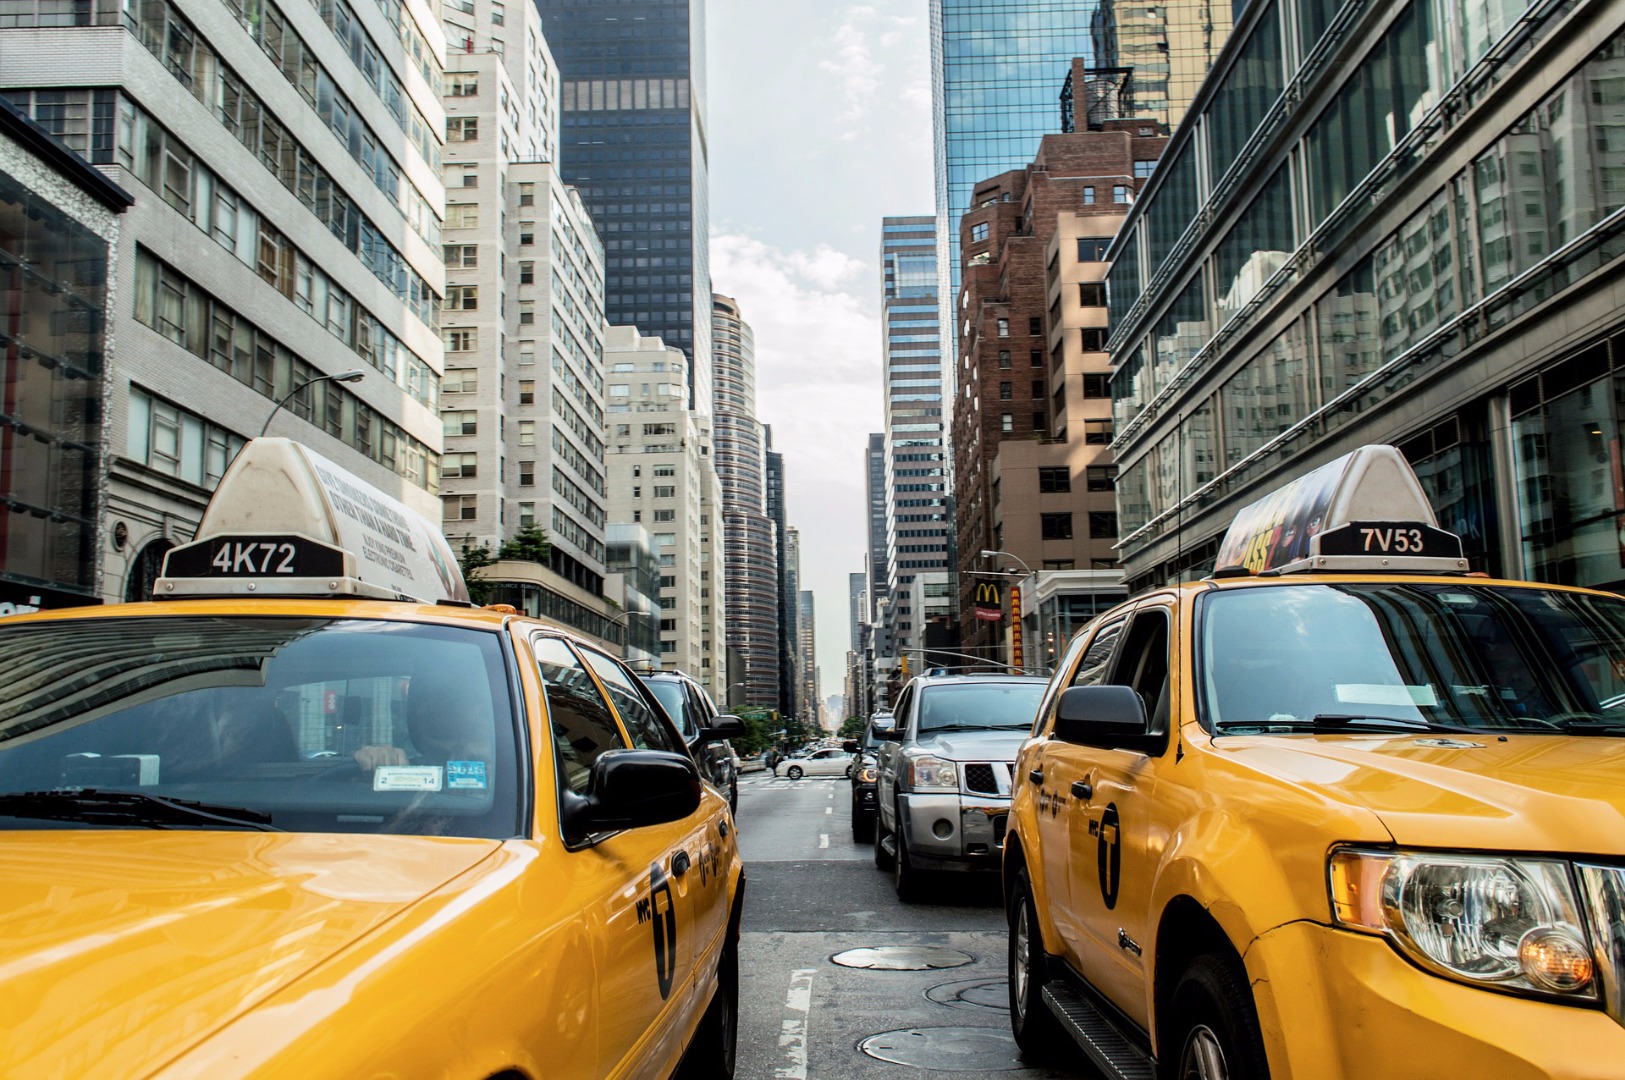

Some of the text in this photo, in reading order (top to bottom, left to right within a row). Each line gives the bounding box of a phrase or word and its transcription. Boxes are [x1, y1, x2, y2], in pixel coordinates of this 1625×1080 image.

[329, 490, 359, 521] OTHER
[354, 504, 377, 531] THAN
[378, 518, 400, 544] HARD
[1360, 528, 1423, 552] 7V53
[213, 542, 296, 573] 4K72
[635, 897, 652, 925] NYC
